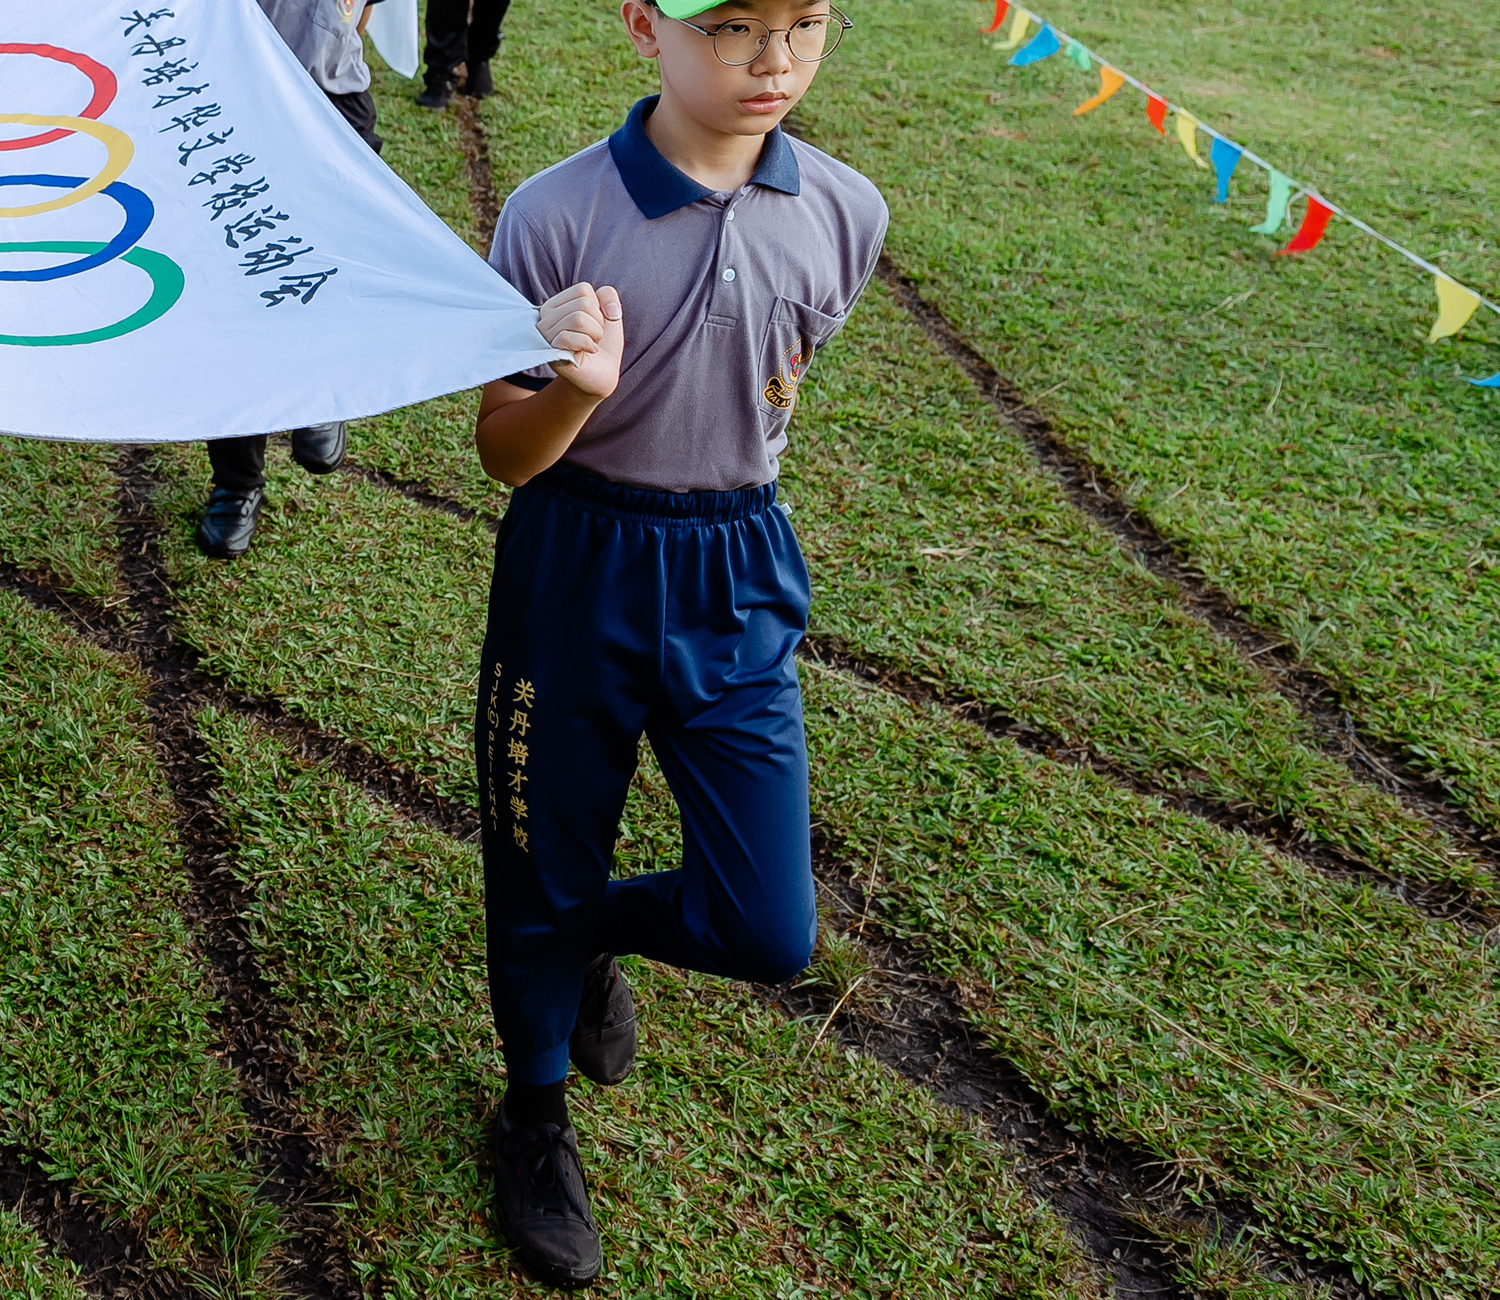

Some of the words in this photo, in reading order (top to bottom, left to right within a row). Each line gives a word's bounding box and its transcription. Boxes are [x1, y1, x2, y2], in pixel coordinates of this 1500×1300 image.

[119, 7, 339, 308] 关丹培才华文学校运动会
[487, 729, 495, 774] PEI
[487, 777, 498, 832] CHAI
[507, 677, 536, 853] 关丹培才学校
